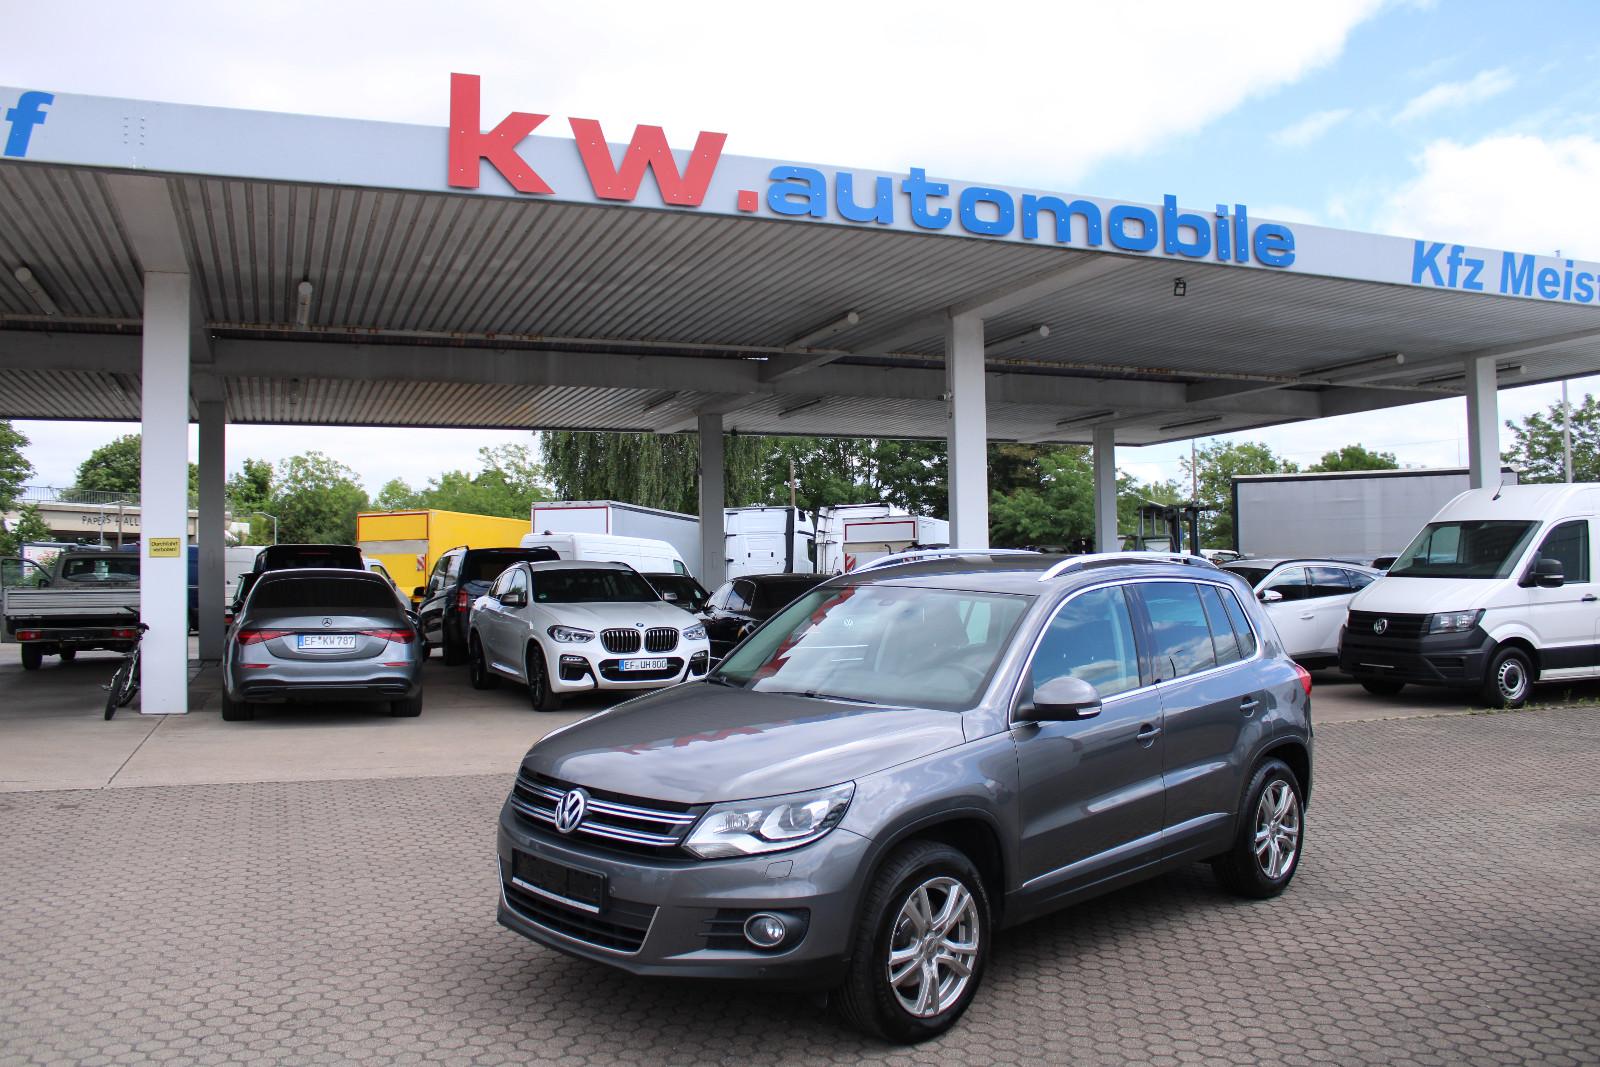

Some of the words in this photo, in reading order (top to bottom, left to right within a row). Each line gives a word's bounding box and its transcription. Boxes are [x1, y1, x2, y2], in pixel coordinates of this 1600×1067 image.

[1412, 240, 1485, 290] Kfz
[1500, 251, 1600, 303] Meis
[124, 516, 139, 526] ALL
[304, 636, 316, 646] EF
[322, 636, 335, 646] KW
[337, 636, 354, 646] 787
[624, 661, 634, 670] EF
